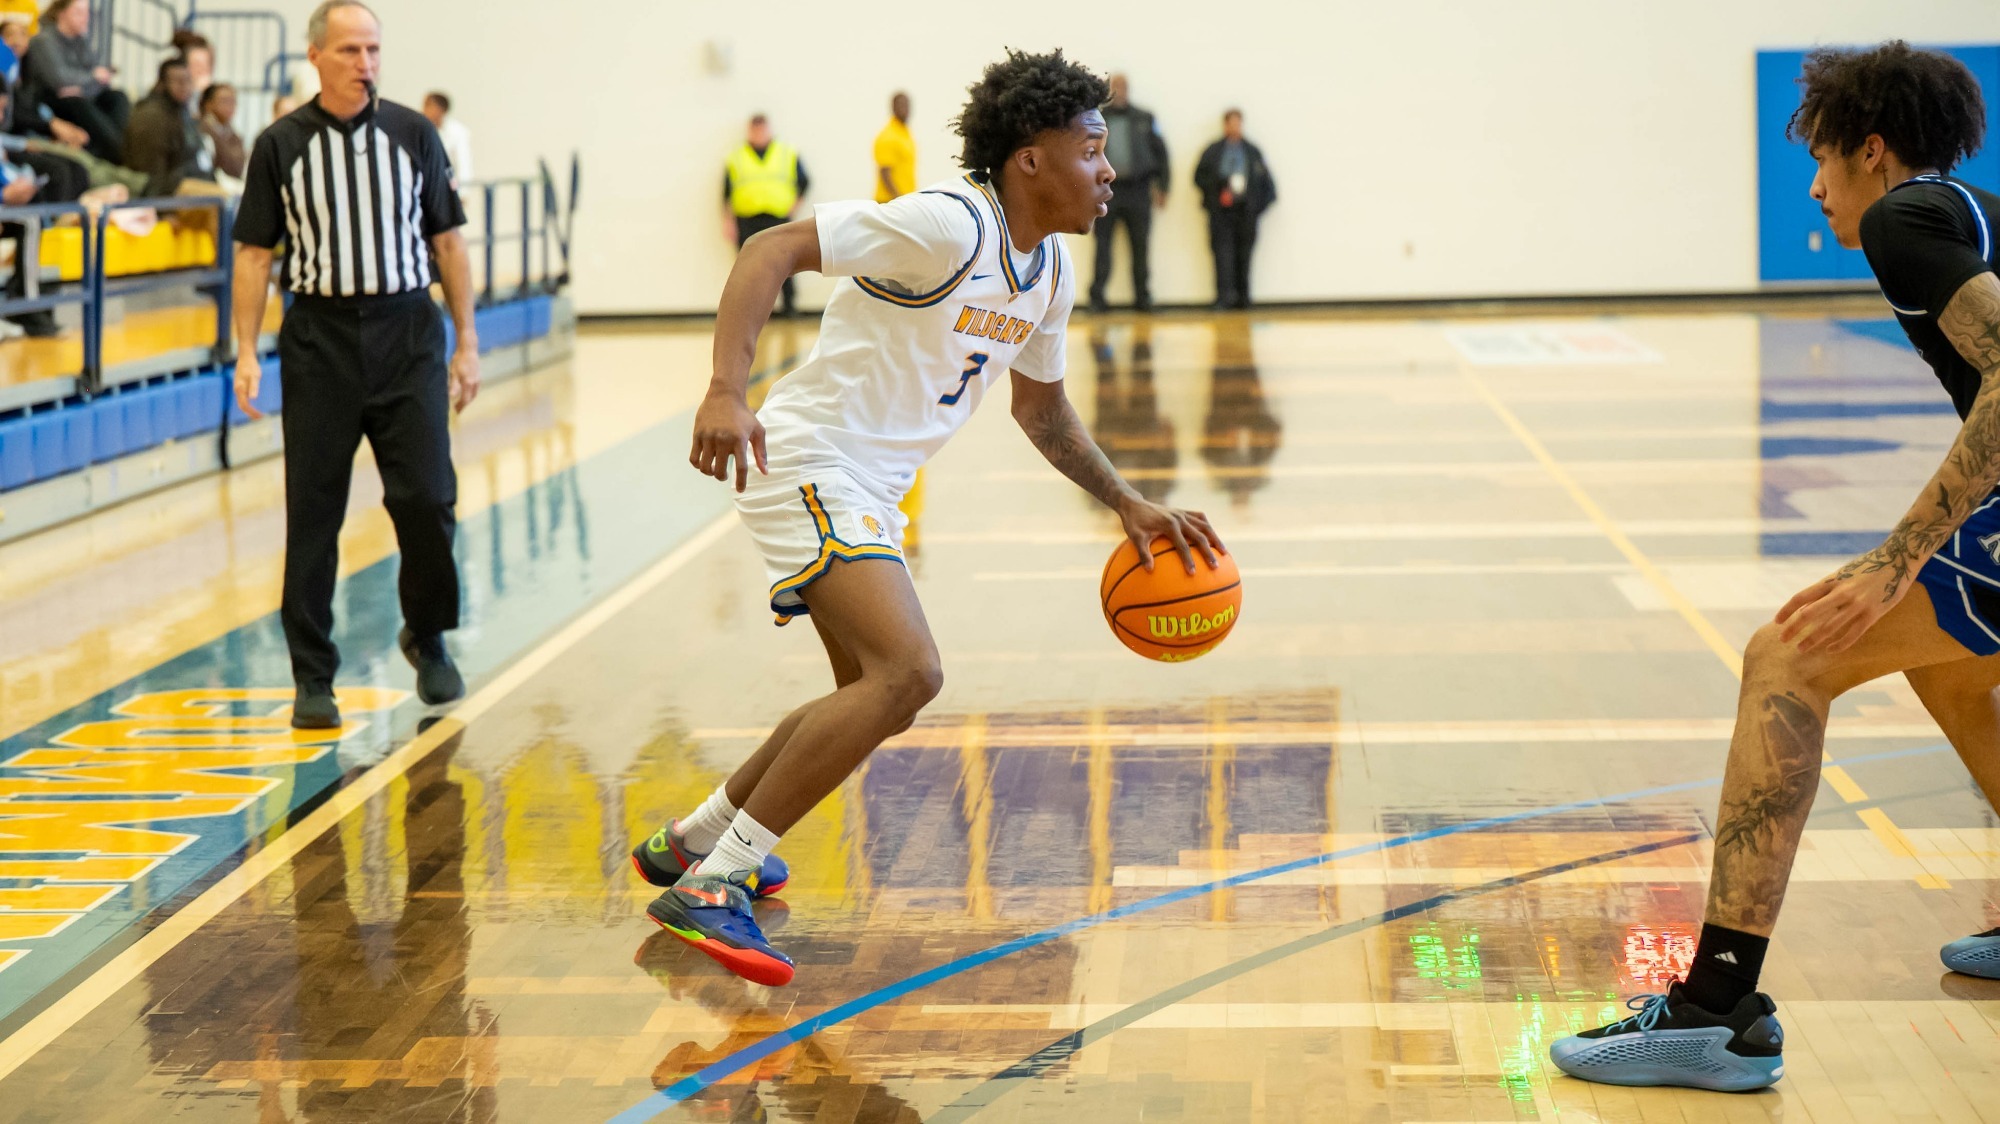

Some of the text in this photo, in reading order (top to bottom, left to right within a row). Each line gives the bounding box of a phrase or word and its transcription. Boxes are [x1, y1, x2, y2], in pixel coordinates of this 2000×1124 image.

[953, 305, 1034, 344] WILDCATS
[938, 351, 989, 407] 3
[1148, 604, 1234, 638] Wilson
